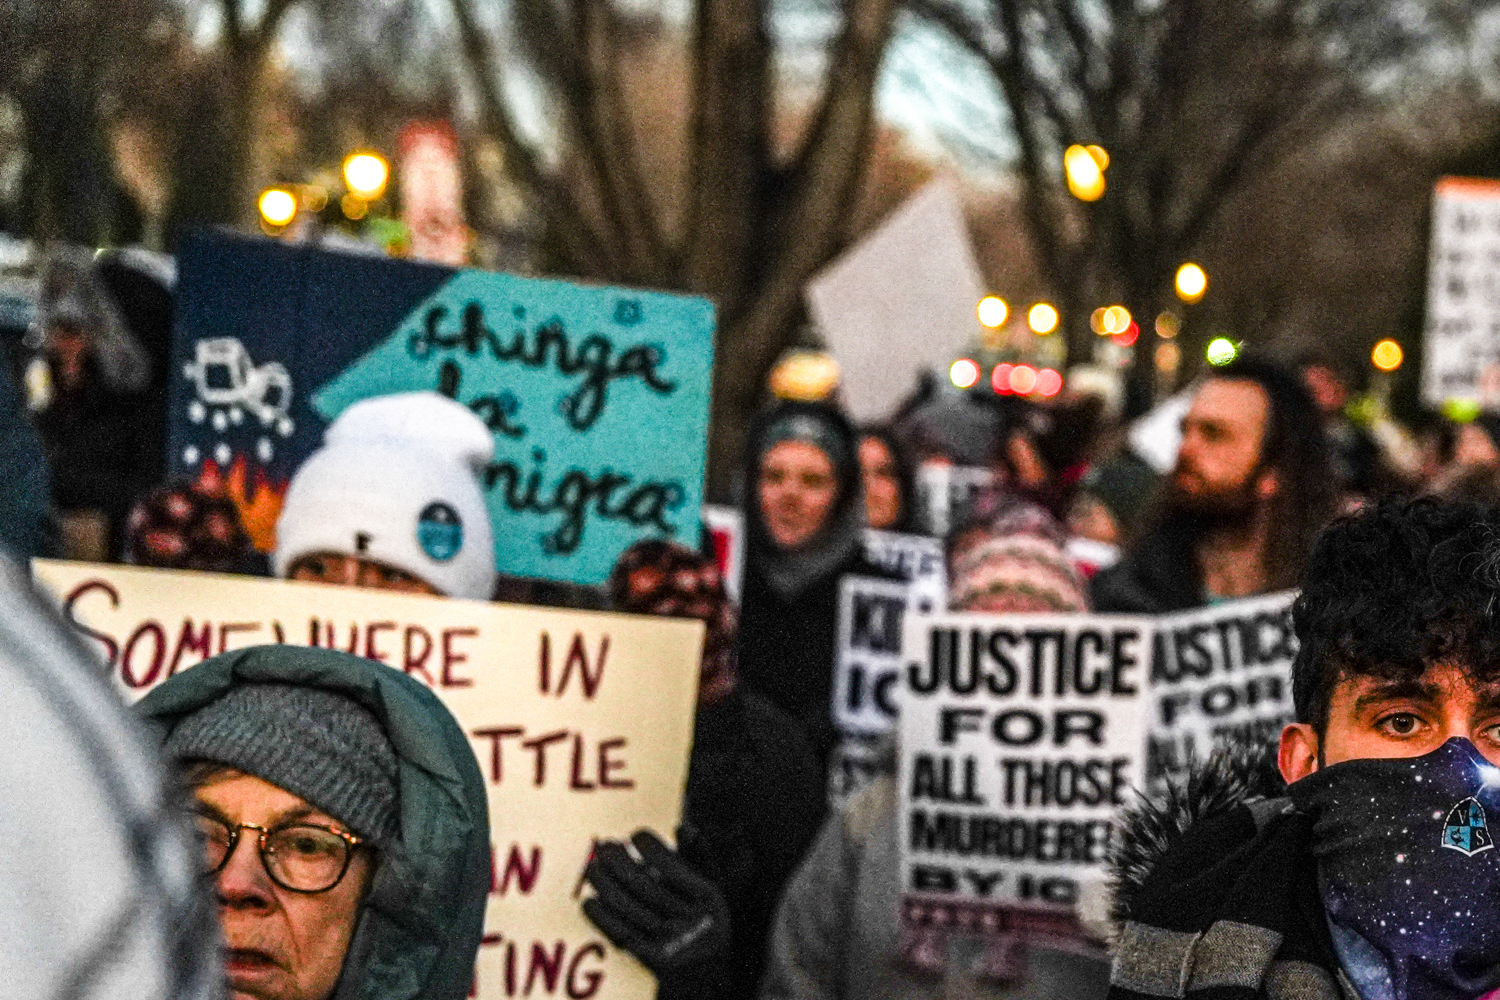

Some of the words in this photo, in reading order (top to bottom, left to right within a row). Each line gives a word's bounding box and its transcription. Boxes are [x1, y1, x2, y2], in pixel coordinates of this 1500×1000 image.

[408, 301, 677, 433] chinga
[538, 631, 611, 701] IN
[907, 626, 1140, 698] JUSTICE
[1151, 611, 1294, 684] USTIC
[472, 726, 636, 792] TTLE
[938, 706, 1107, 748] FOR
[910, 753, 984, 806] ALL
[1001, 757, 1128, 809] THOSE
[1475, 829, 1485, 846] S
